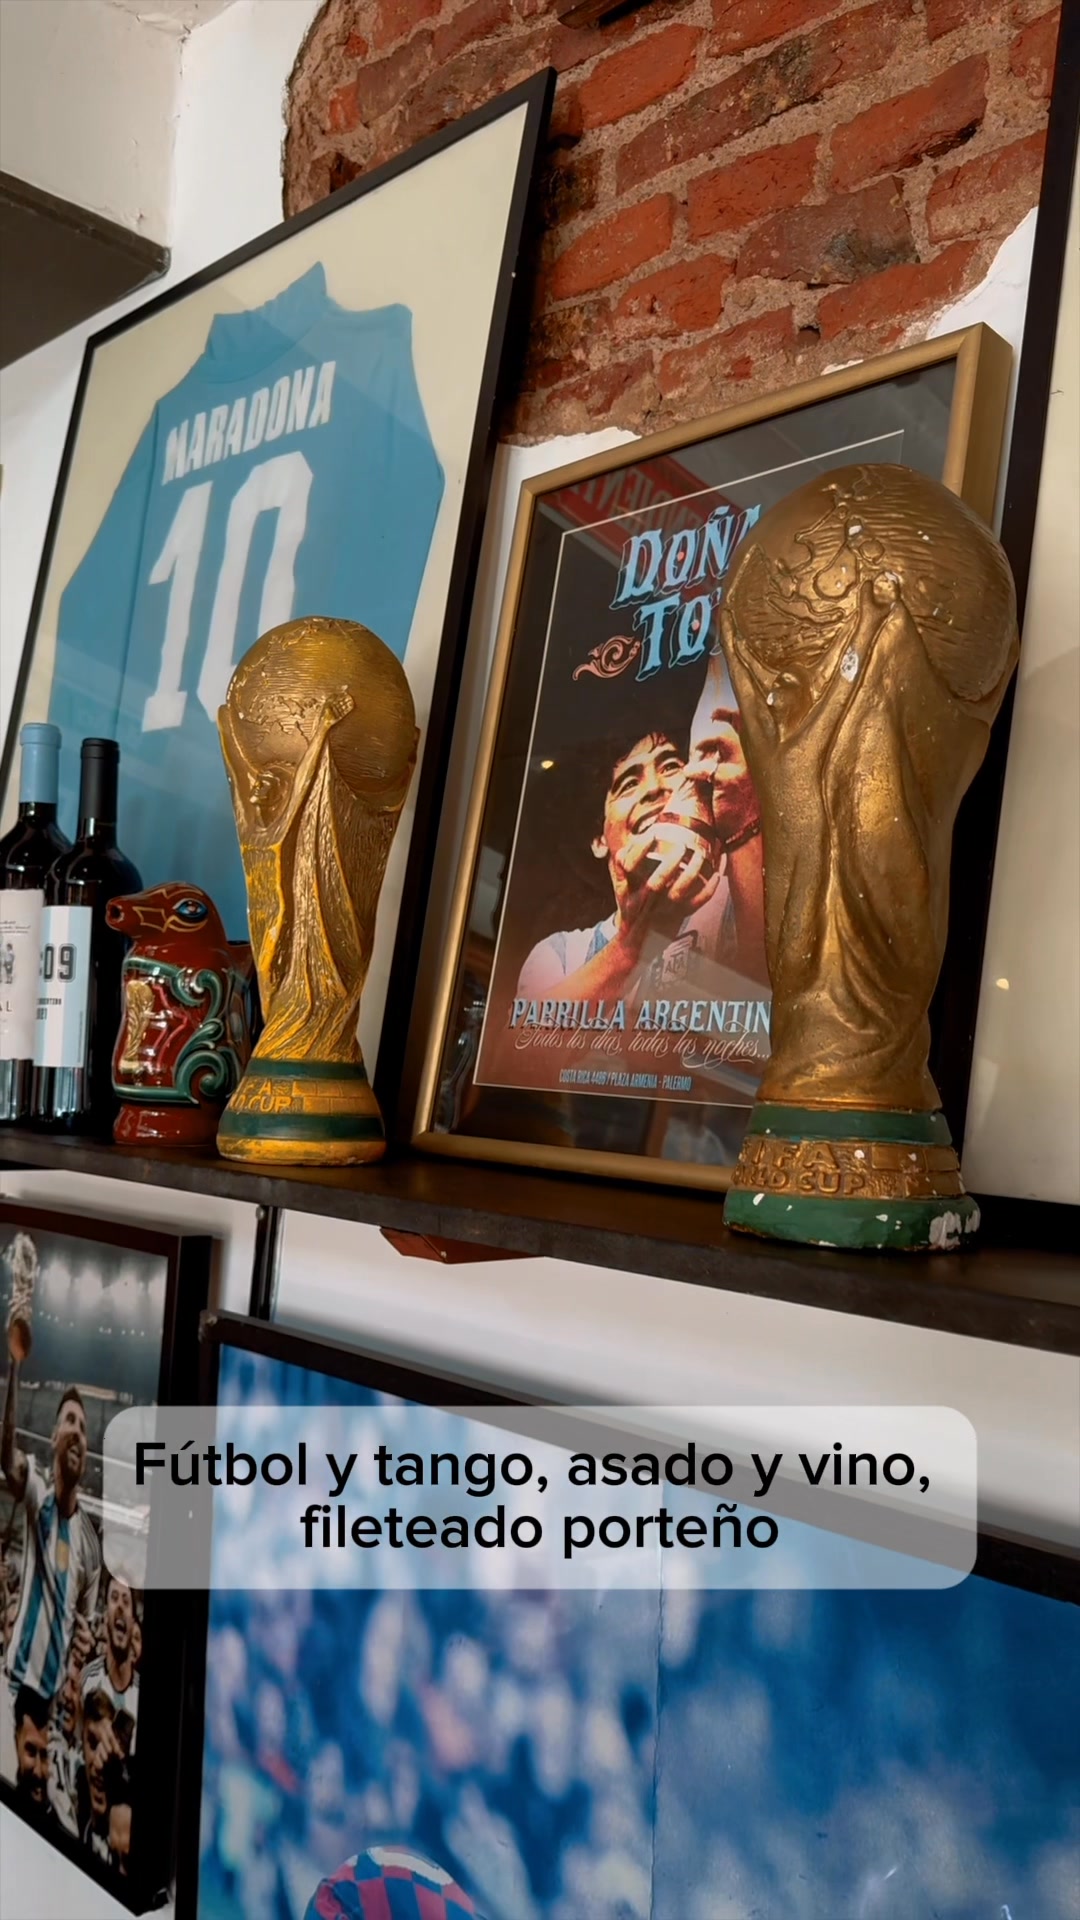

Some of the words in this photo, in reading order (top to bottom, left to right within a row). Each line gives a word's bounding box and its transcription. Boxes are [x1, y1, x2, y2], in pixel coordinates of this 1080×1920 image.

[162, 361, 336, 486] MARADONA
[142, 450, 314, 731] 10
[632, 587, 723, 682] TO
[509, 998, 627, 1032] PARRILLA
[632, 998, 772, 1035] ARGENTIN
[514, 1018, 564, 1050] Todos
[566, 1018, 587, 1050] los
[628, 1018, 671, 1058] todas
[611, 1072, 630, 1087] PLAZA
[630, 1073, 658, 1089] ARMENIA
[662, 1075, 693, 1092] PALERMO
[798, 1171, 866, 1195] CUP
